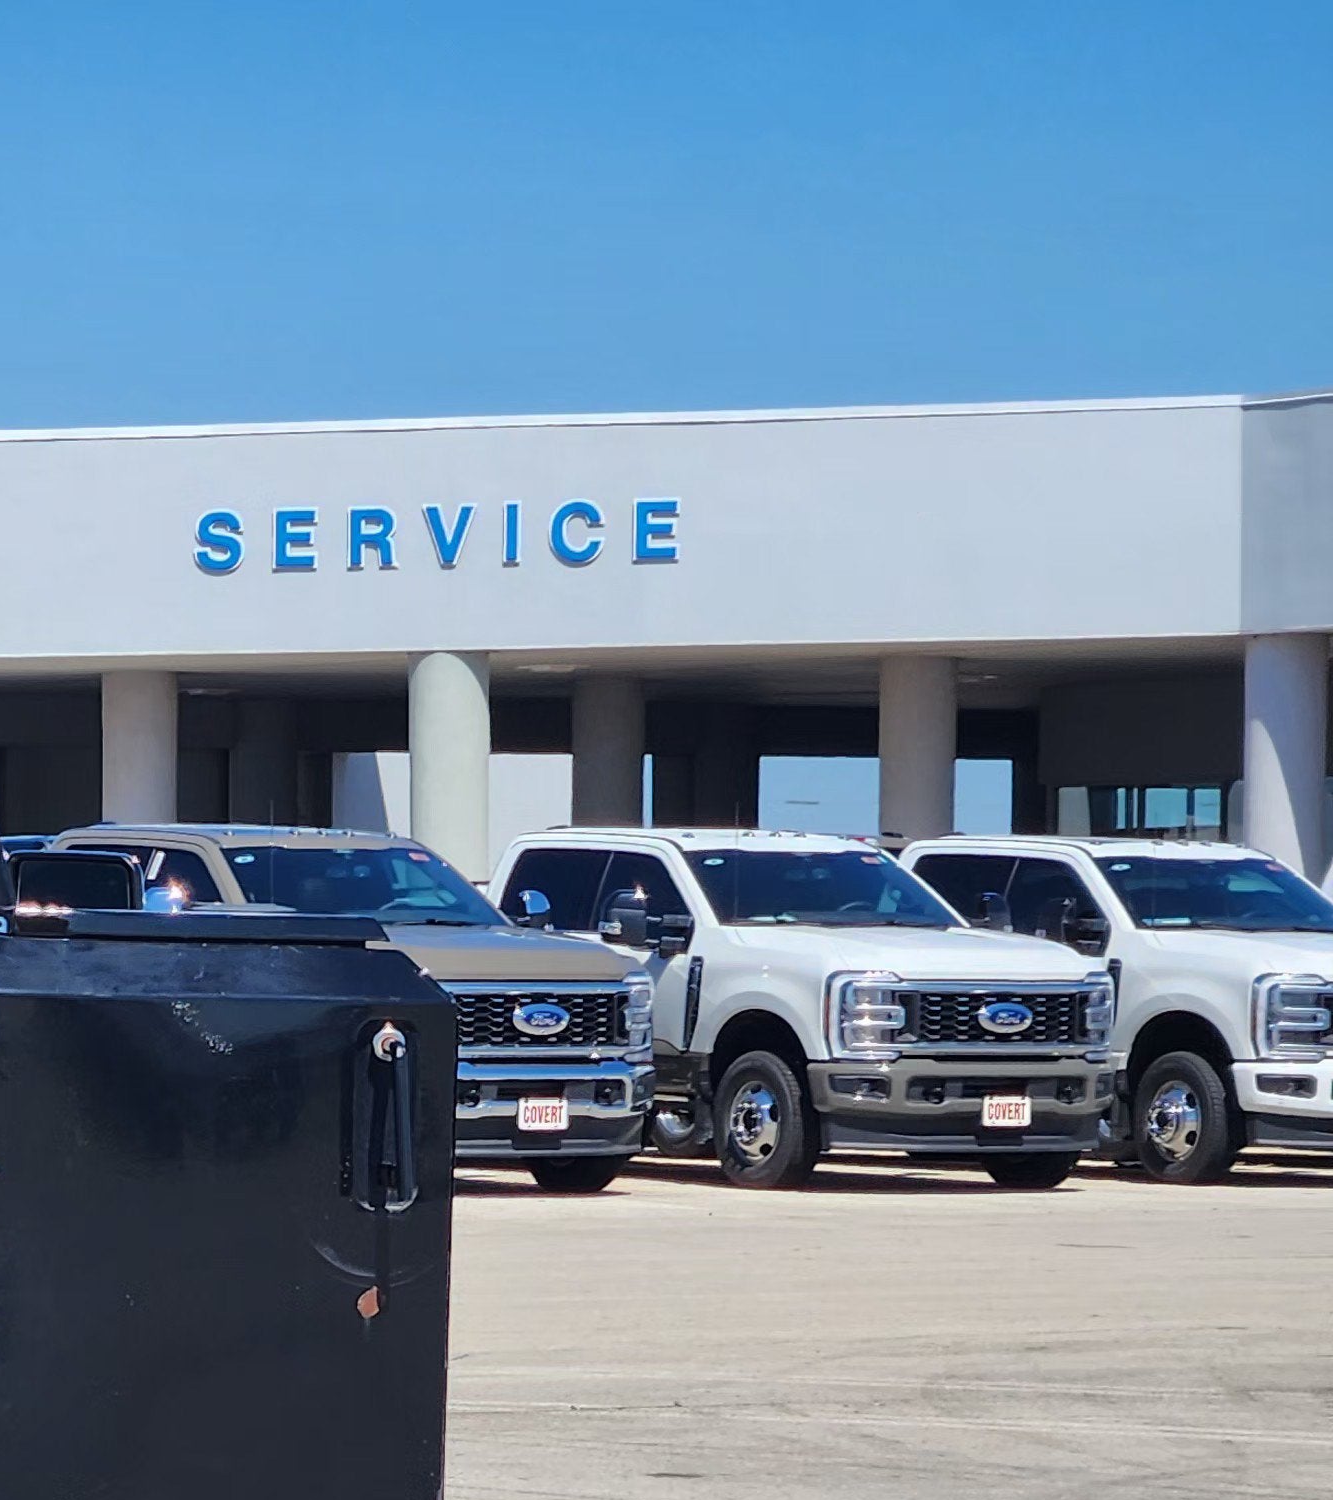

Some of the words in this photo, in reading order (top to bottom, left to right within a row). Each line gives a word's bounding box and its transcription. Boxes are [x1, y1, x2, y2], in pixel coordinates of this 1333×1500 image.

[193, 496, 681, 574] SERVICE
[523, 1104, 563, 1124] COVERT
[988, 1102, 1026, 1120] COVERT
